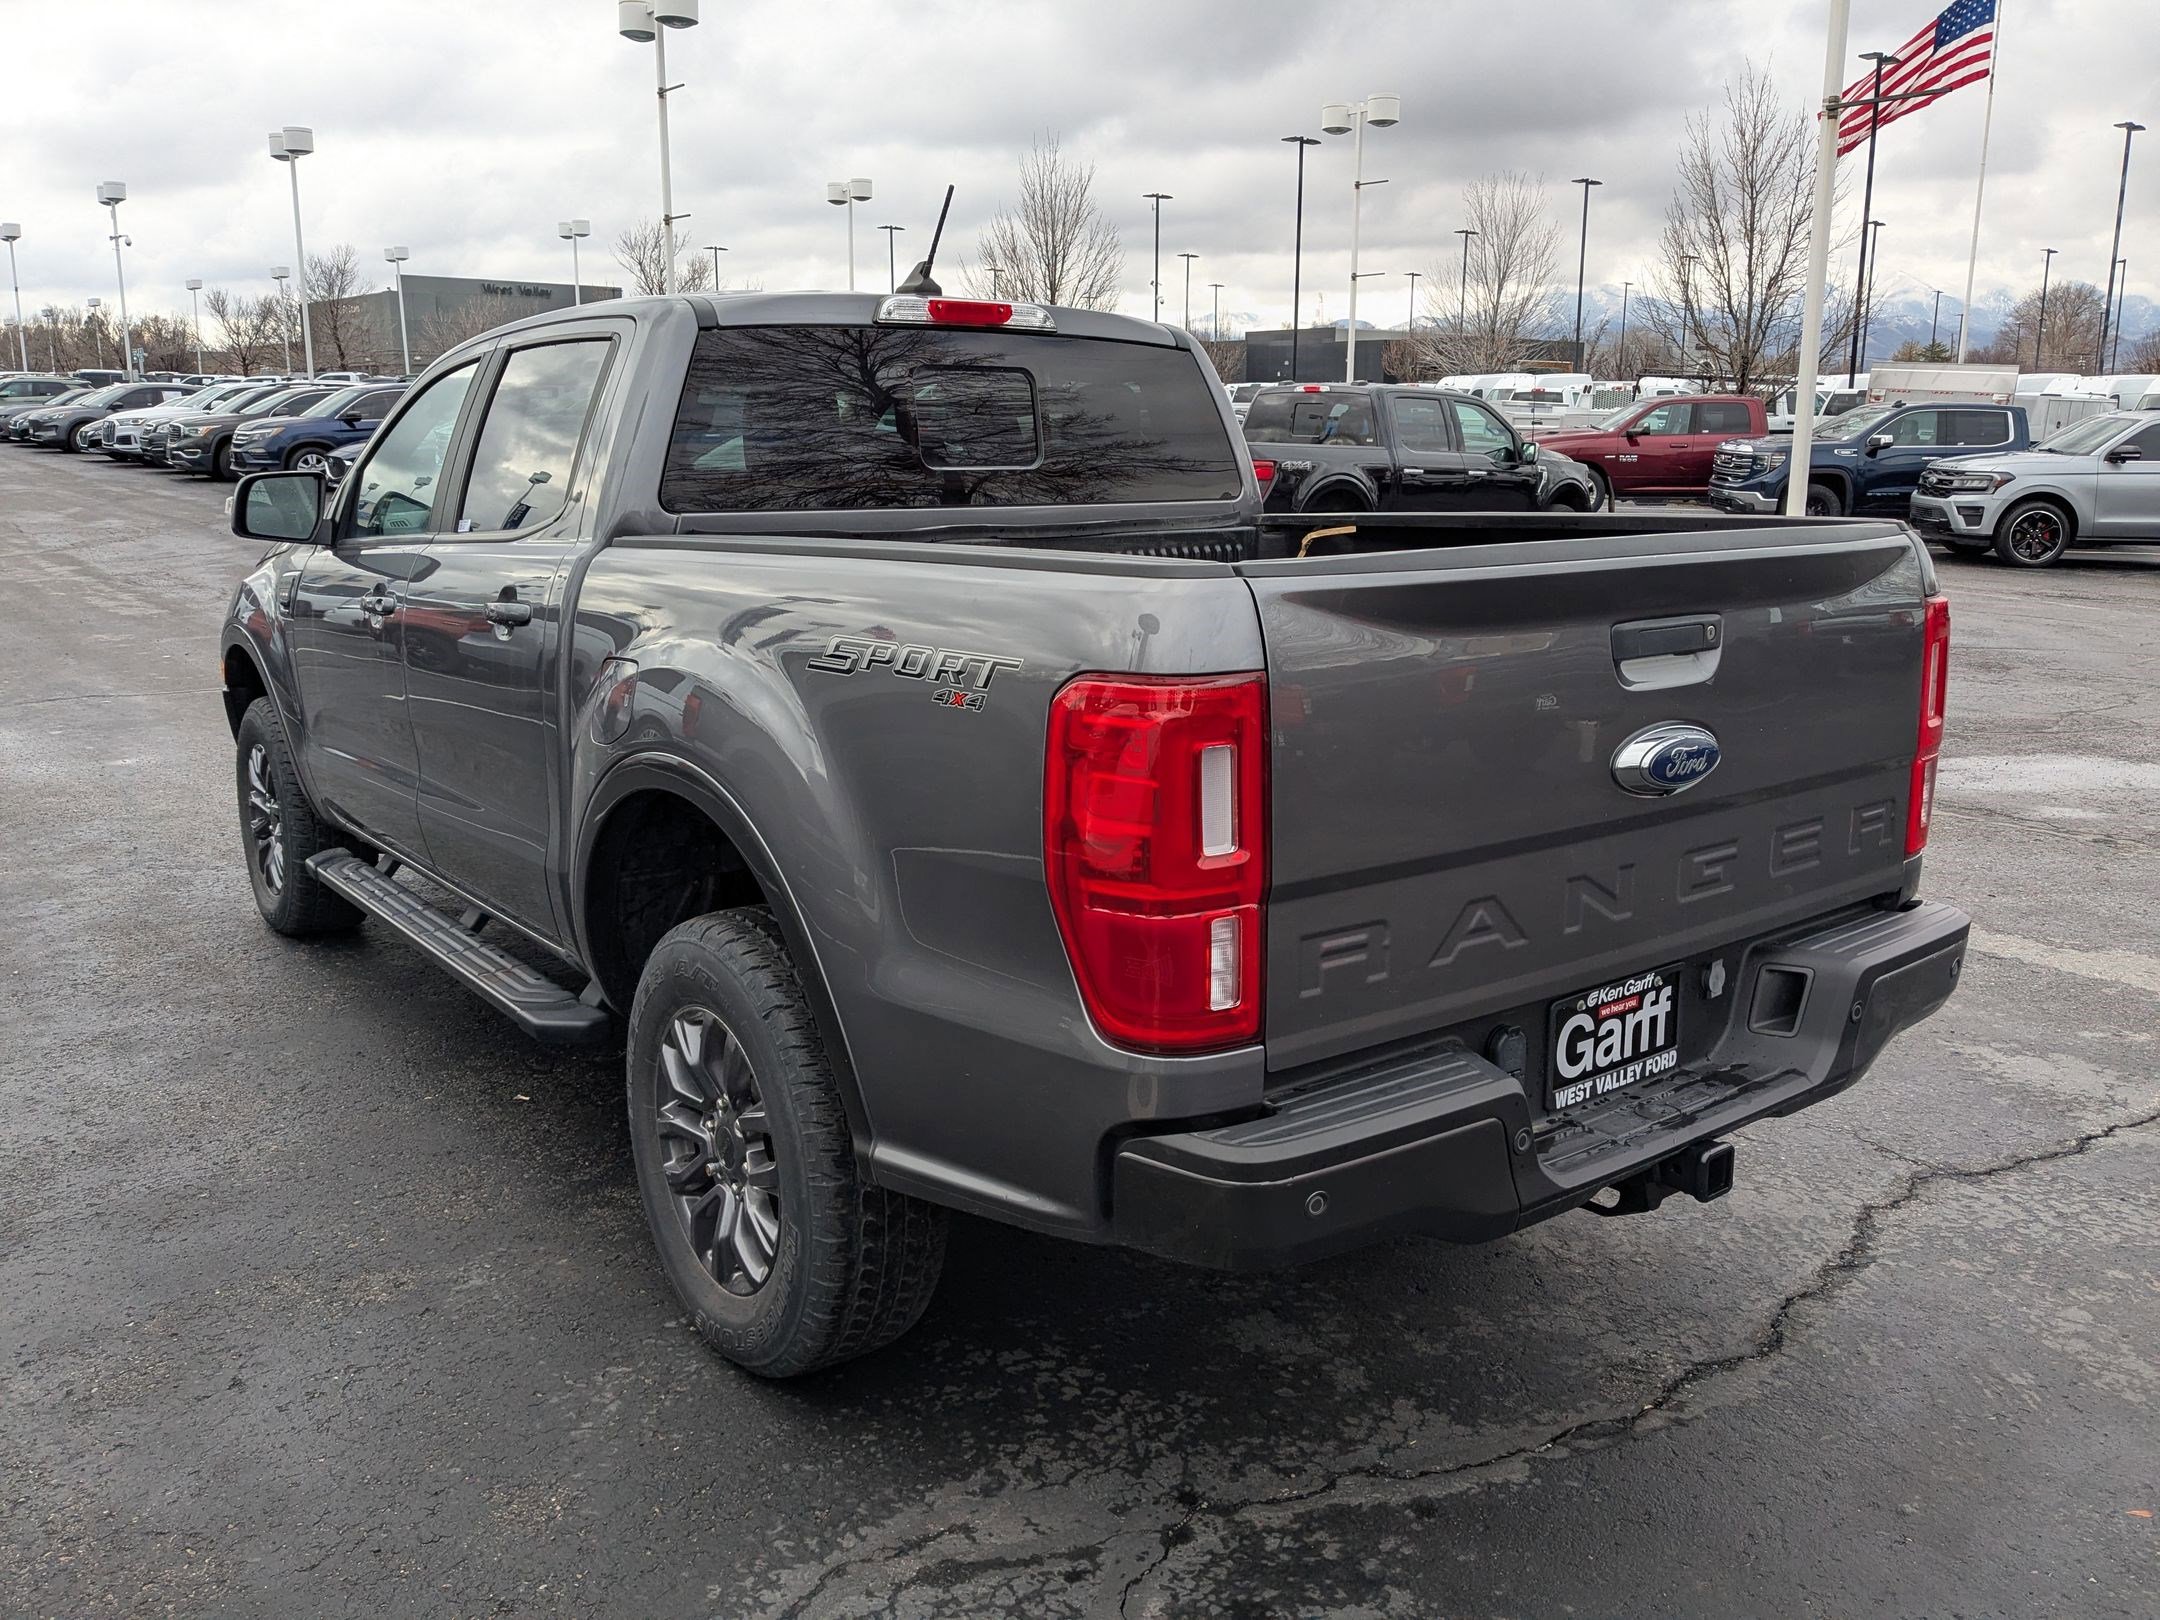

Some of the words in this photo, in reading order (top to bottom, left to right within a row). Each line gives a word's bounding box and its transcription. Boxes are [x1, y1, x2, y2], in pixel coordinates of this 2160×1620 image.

[805, 634, 1024, 691] SPORT
[931, 688, 988, 713] 4x4
[1665, 745, 1709, 778] Ford
[1299, 798, 1896, 998] RANGER
[1598, 987, 1623, 1004] Ken
[1624, 973, 1655, 996] Garff
[1601, 1007, 1611, 1016] we
[1611, 1003, 1625, 1013] hear
[1625, 1000, 1637, 1011] you
[1556, 985, 1672, 1079] Garff
[1555, 1080, 1594, 1109] WEST
[1596, 1061, 1644, 1094] VALLEY
[1645, 1050, 1677, 1077] FORD
